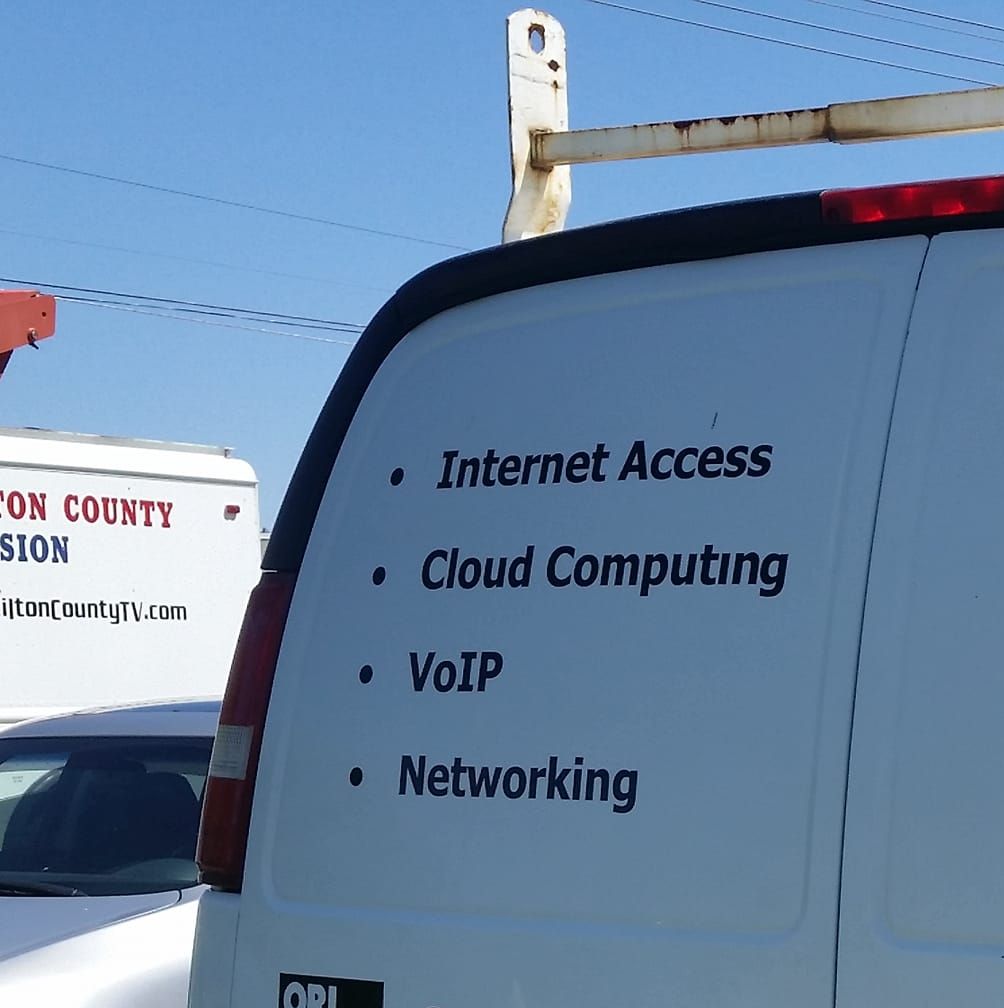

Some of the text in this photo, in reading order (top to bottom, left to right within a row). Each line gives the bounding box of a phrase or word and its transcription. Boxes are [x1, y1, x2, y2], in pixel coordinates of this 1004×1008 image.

[436, 440, 773, 489] Internet Access
[64, 494, 173, 528] COUNTY
[0, 533, 69, 563] SION
[421, 544, 789, 597] Cloud Computing
[409, 651, 504, 693] VoIP
[399, 755, 639, 814] Networking
